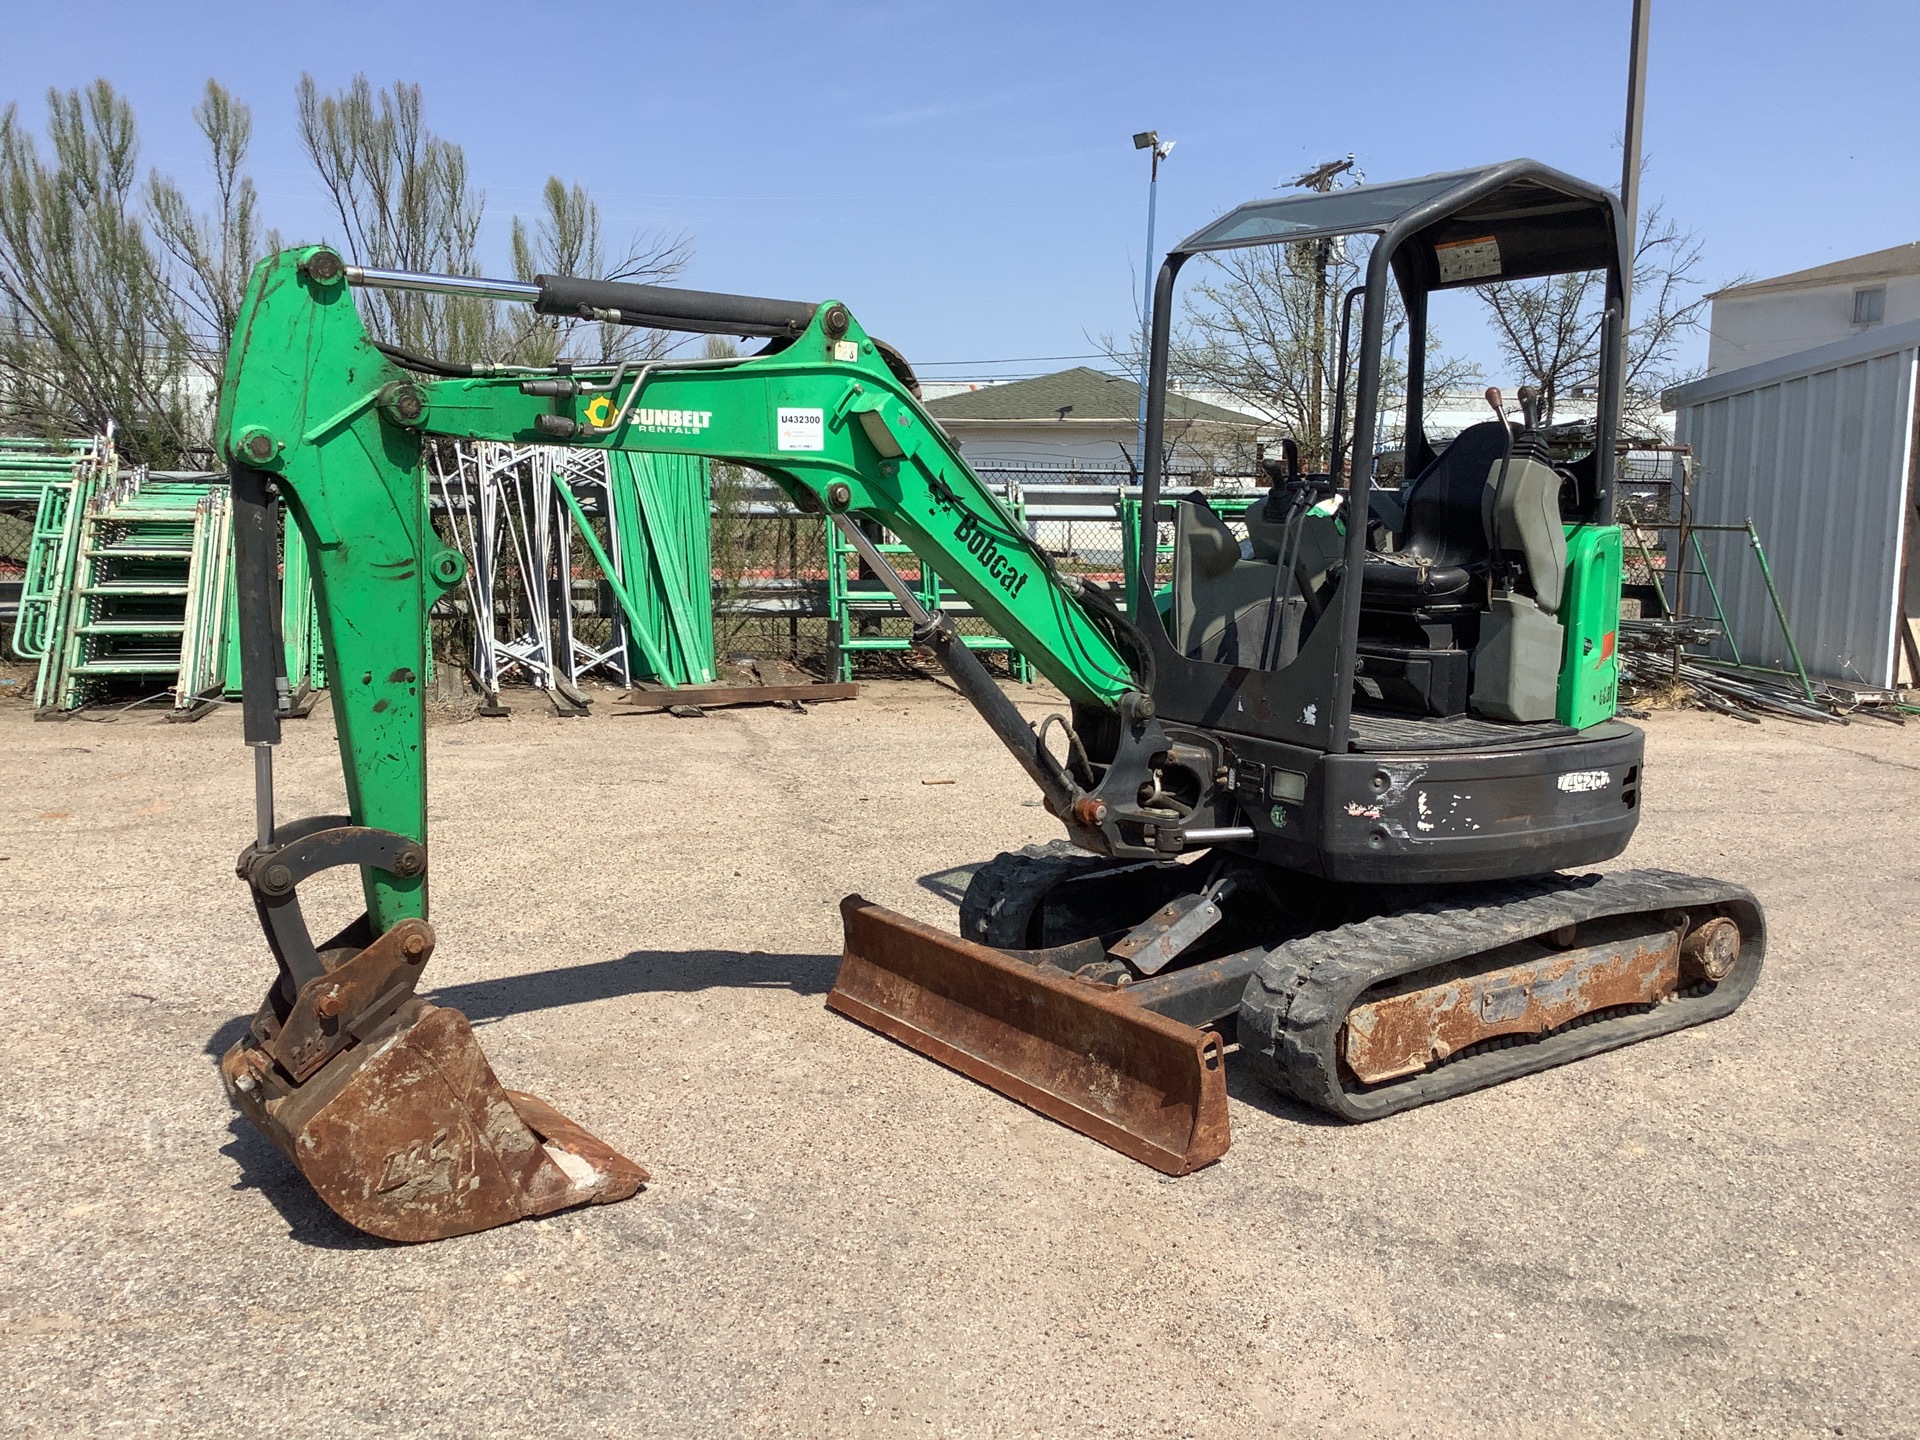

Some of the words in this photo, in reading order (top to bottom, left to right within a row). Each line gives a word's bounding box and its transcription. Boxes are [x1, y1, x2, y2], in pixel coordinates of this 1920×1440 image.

[627, 408, 713, 428] SUNBELT
[781, 415, 821, 424] U432300
[639, 426, 700, 435] RENTALS
[953, 513, 1029, 600] Bobcat
